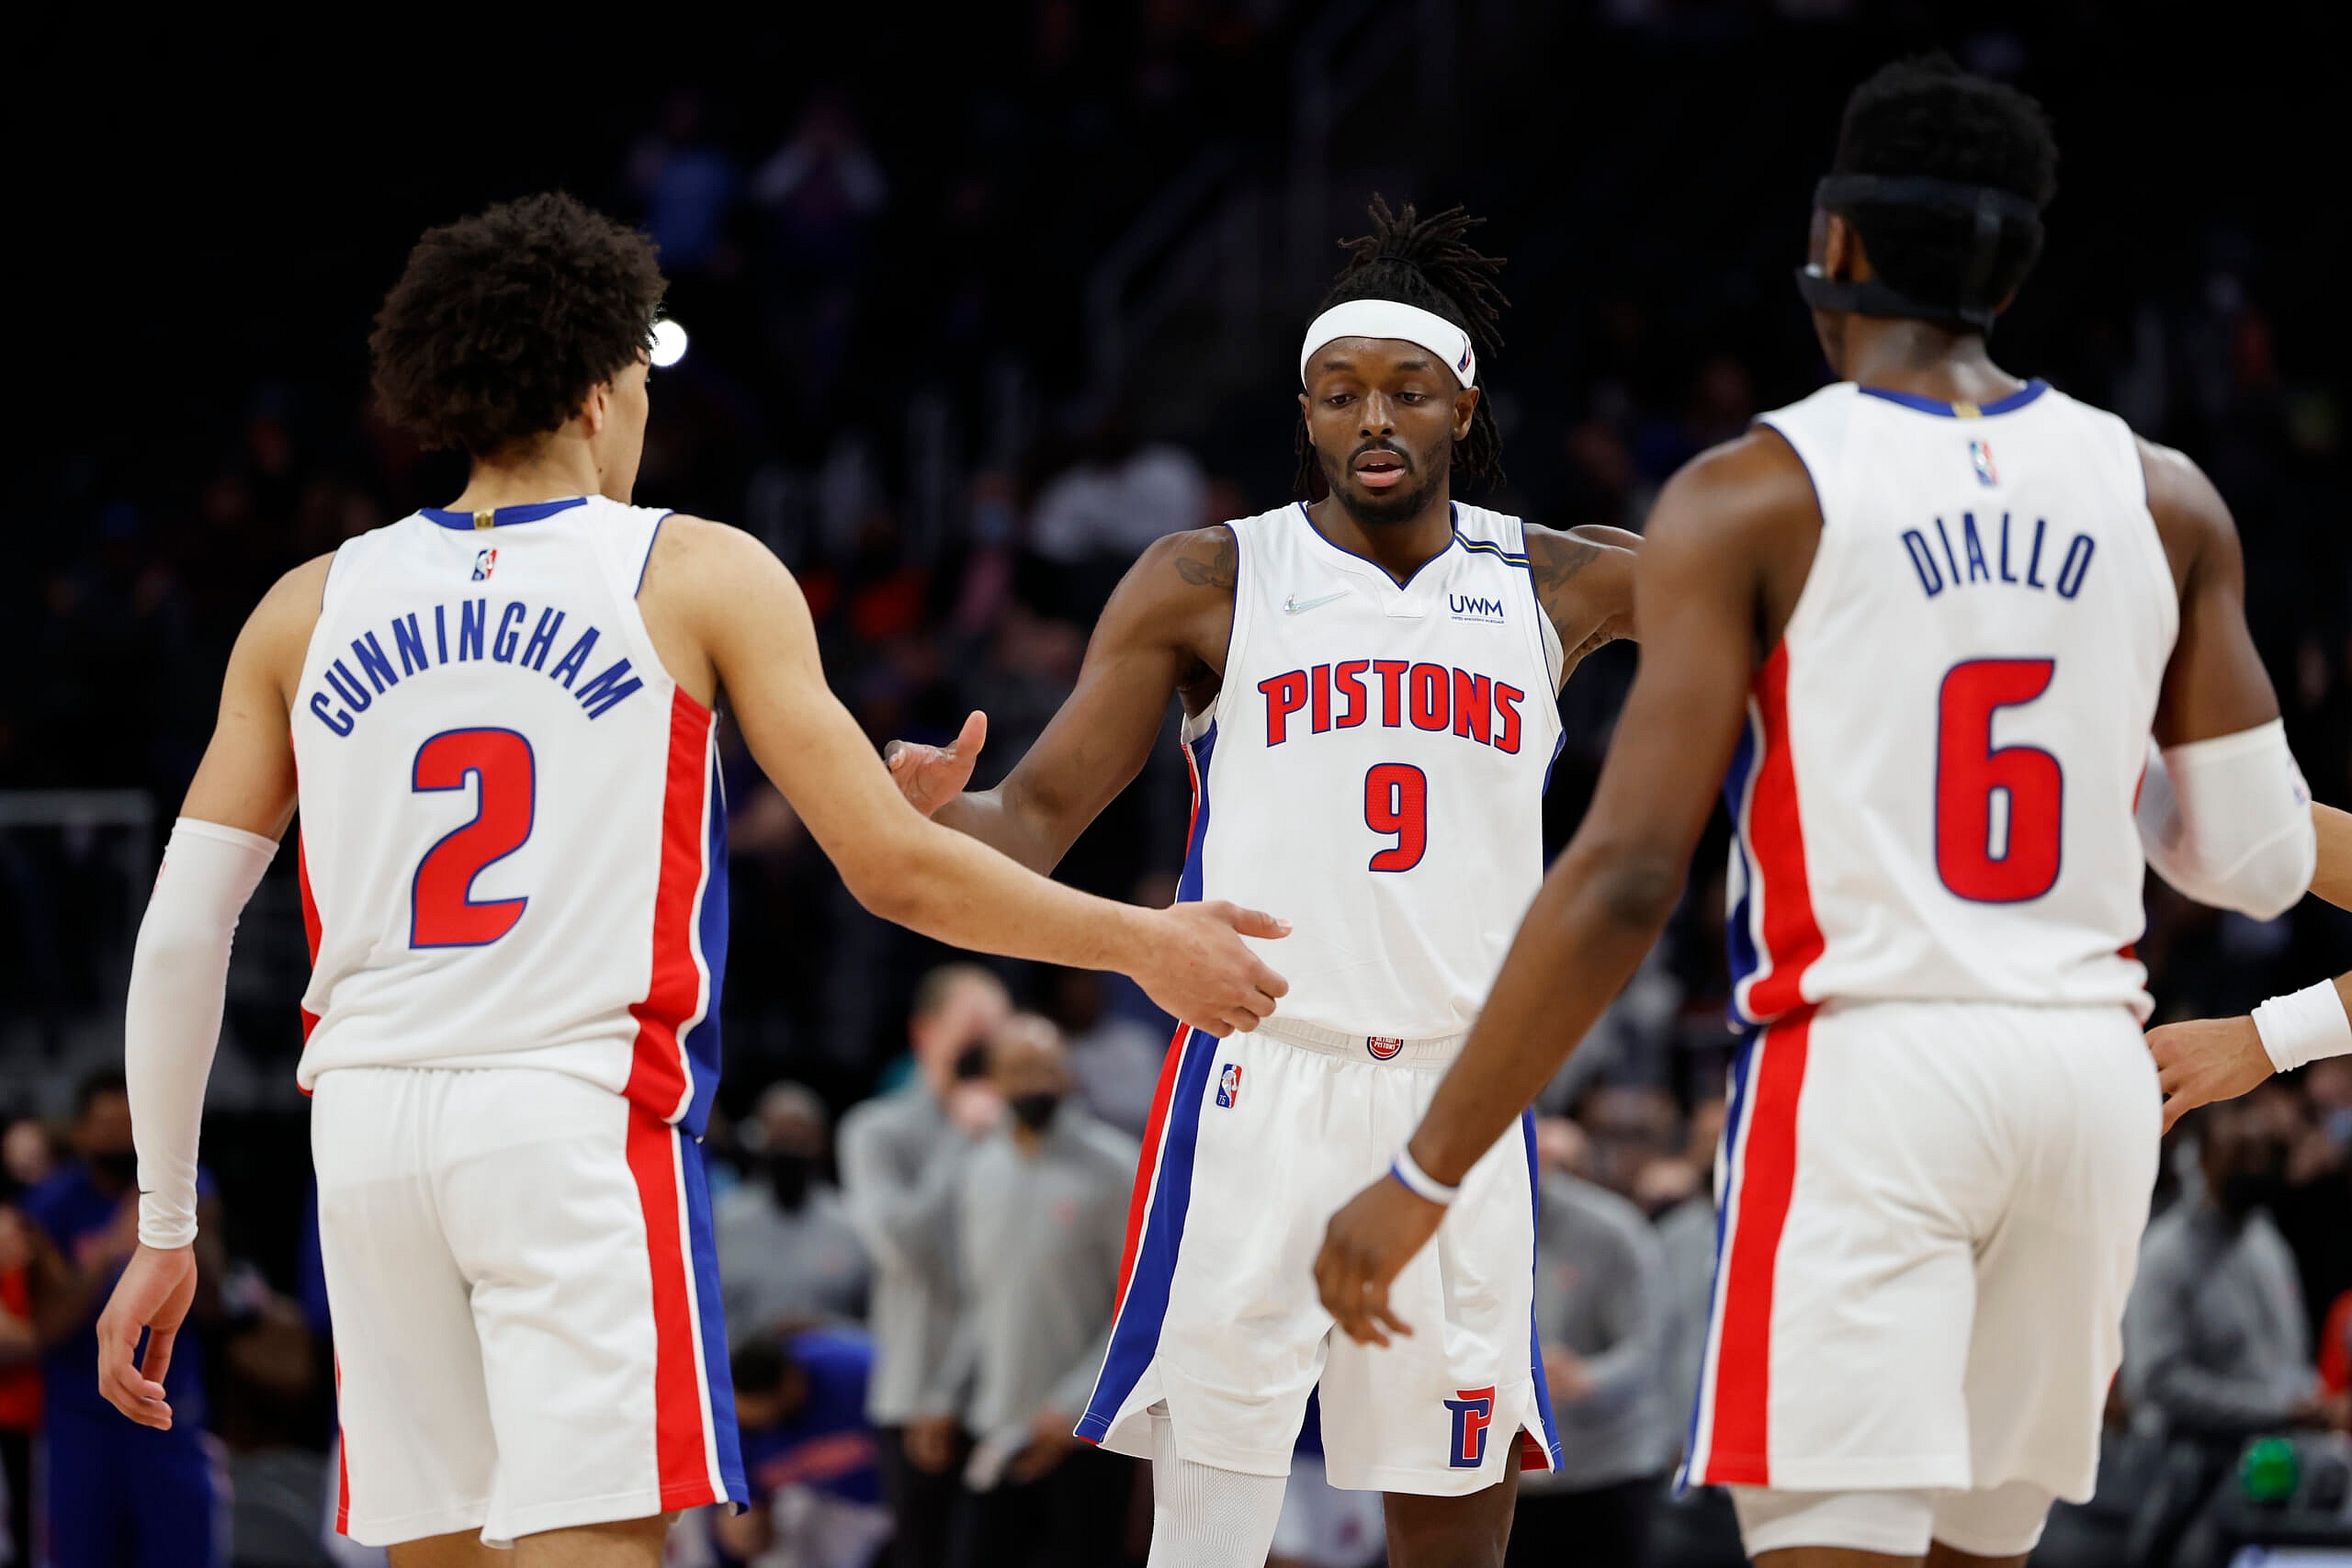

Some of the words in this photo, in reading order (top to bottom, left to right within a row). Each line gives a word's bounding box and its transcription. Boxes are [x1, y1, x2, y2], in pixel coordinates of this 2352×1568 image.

[1450, 593, 1504, 617] UWM
[1902, 513, 2096, 599] DIALLO
[311, 599, 644, 738] CUNNINGHAM
[1258, 659, 1525, 755] PISTONS
[1364, 762, 1428, 873] 9
[1936, 658, 2064, 904] 6
[410, 728, 536, 950] 2
[1218, 1094, 1227, 1105] 75
